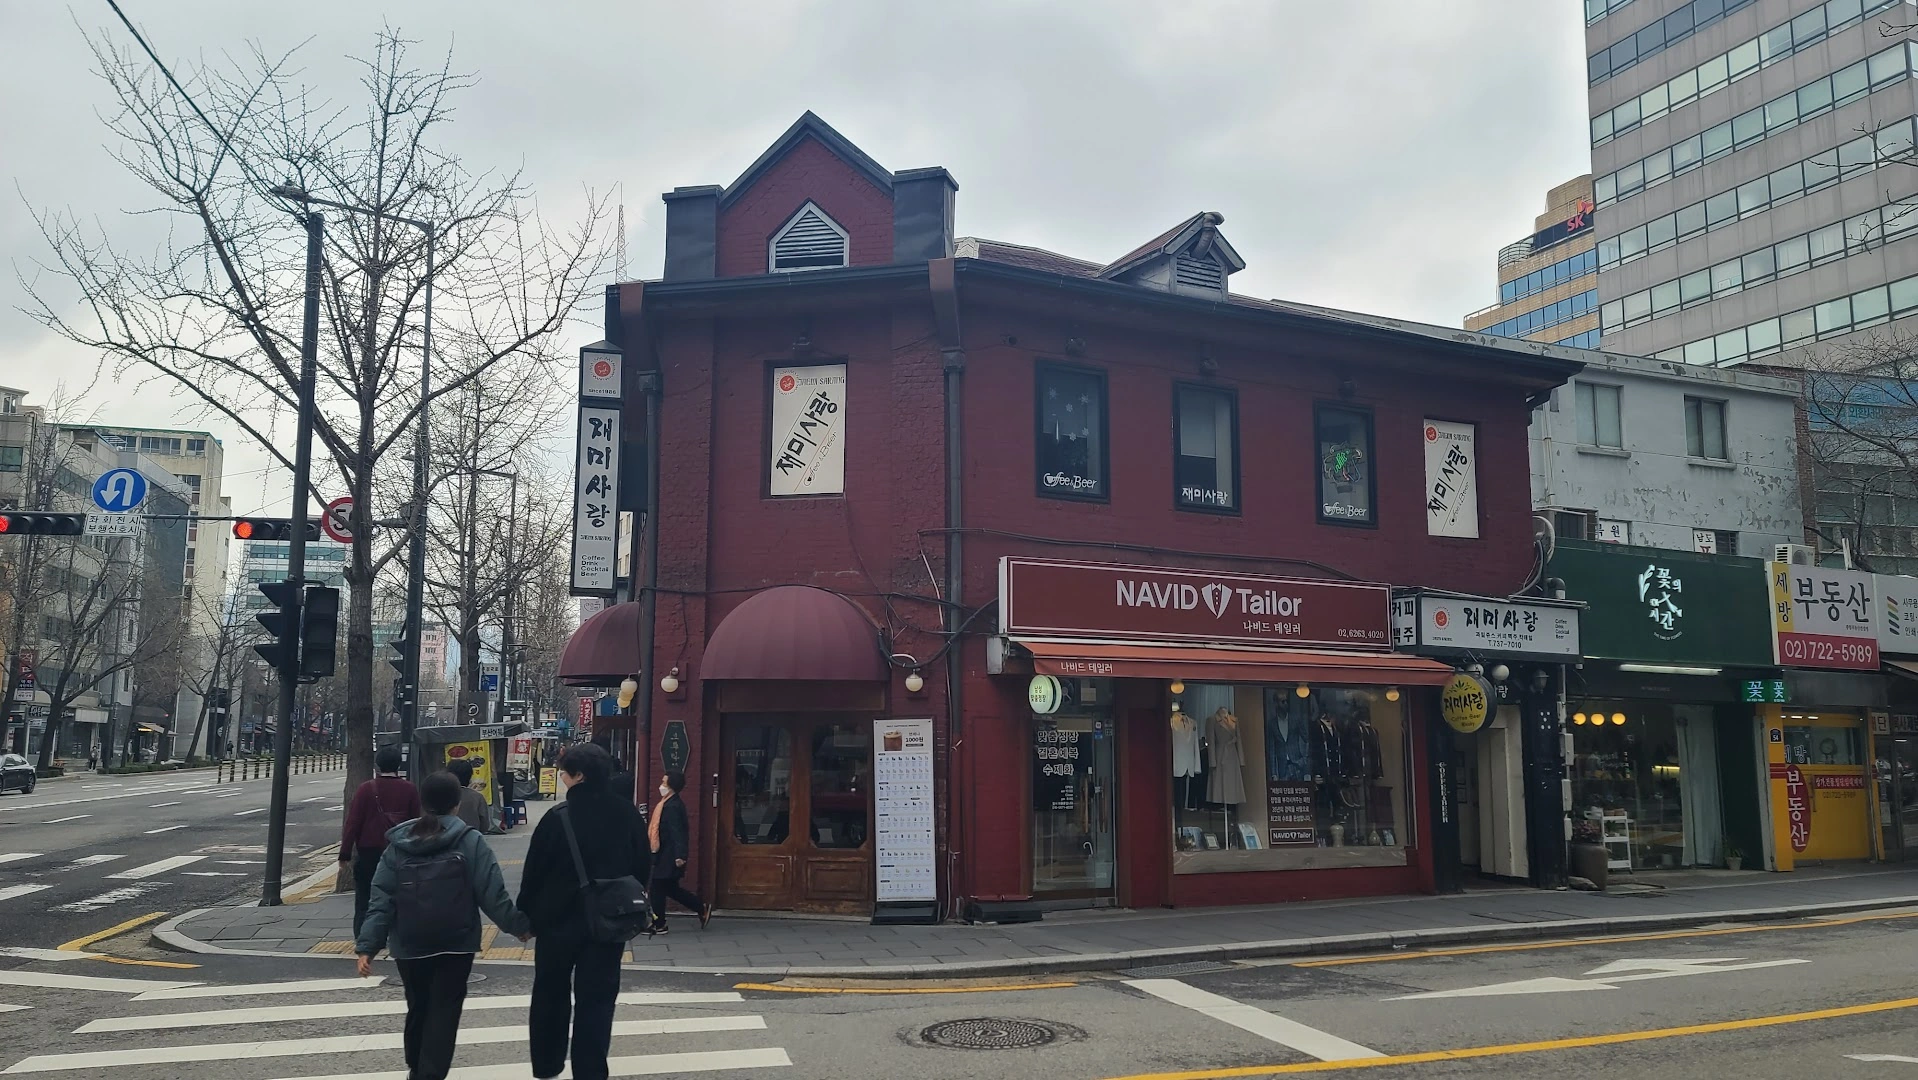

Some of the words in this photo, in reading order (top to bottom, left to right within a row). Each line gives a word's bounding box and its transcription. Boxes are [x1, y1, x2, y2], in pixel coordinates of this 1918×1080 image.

[1567, 213, 1585, 232] SK
[775, 391, 838, 476] 재미사랑
[584, 417, 612, 528] 재미사랑
[1427, 444, 1468, 517] 재미사랑
[1181, 486, 1228, 505] 재미사랑
[1116, 579, 1199, 610] NAVID
[1236, 587, 1302, 617] Tailor
[1775, 571, 1791, 623] 세방
[1794, 577, 1871, 623] 부동산
[1243, 621, 1271, 634] 나비드
[1274, 622, 1302, 636] 테일러
[1463, 607, 1539, 633] 재미사랑
[1648, 608, 1675, 630] 시간
[1784, 639, 1873, 663] 02)722-5989
[1060, 662, 1086, 673] 나비드
[1088, 662, 1113, 674] 테일러
[1747, 681, 1764, 698] 꽃
[1773, 681, 1785, 698] 꽃
[1444, 691, 1483, 713] 재미사랑
[1037, 730, 1079, 743] 맞춤정장
[1037, 747, 1079, 760] 결혼예복
[1042, 763, 1074, 776] 수제화
[1786, 770, 1808, 847] 부동산
